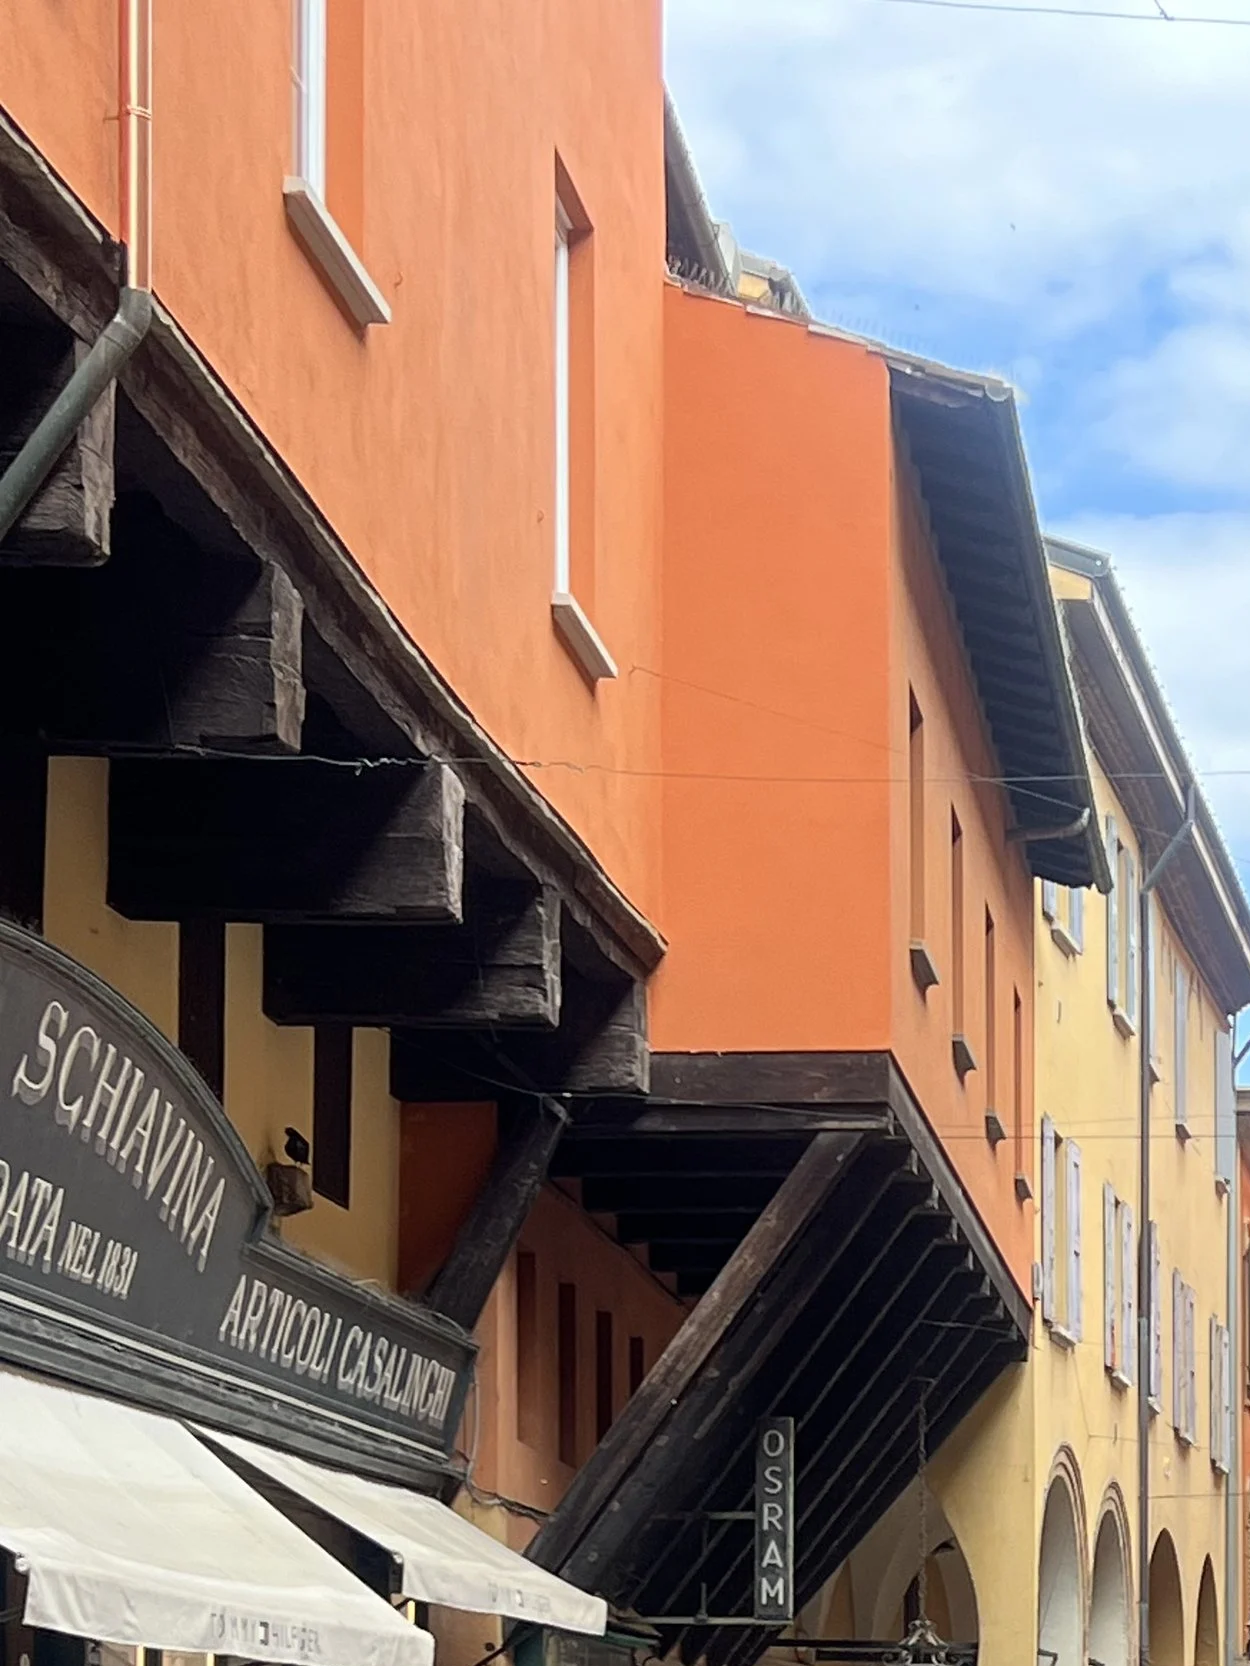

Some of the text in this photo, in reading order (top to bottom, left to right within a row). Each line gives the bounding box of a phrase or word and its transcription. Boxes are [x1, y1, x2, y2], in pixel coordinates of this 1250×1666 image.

[12, 1000, 226, 1270] SCHIAVINA
[57, 1221, 101, 1285] NEL
[96, 1239, 138, 1299] 1831
[219, 1274, 342, 1383] ARTICOLI
[760, 1429, 785, 1606] OSRAM
